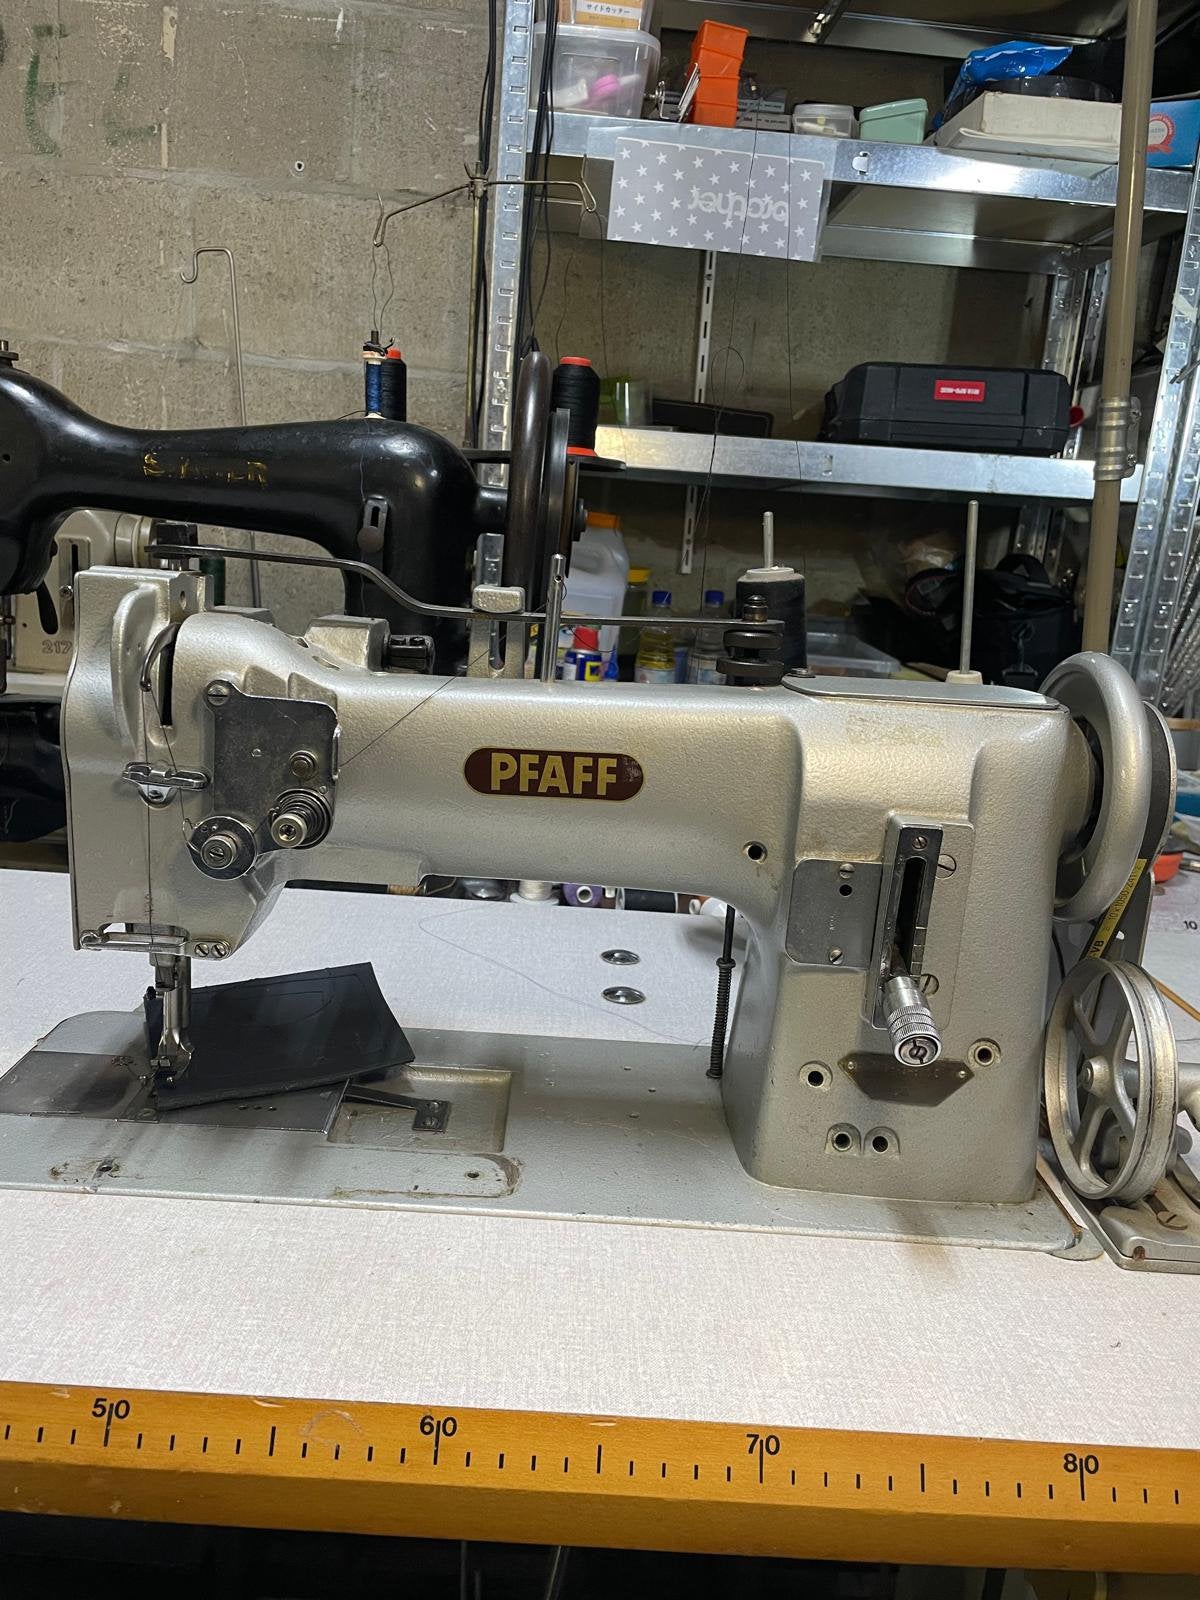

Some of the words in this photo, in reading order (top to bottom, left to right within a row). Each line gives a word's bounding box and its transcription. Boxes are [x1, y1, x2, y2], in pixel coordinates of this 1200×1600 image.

[688, 190, 789, 227] brother
[41, 639, 73, 654] 217
[491, 752, 617, 796] PFAFF
[1184, 920, 1198, 930] 10
[92, 1398, 130, 1419] 50
[420, 1415, 457, 1437] 60
[746, 1434, 780, 1455] 70
[1063, 1453, 1099, 1474] 80
